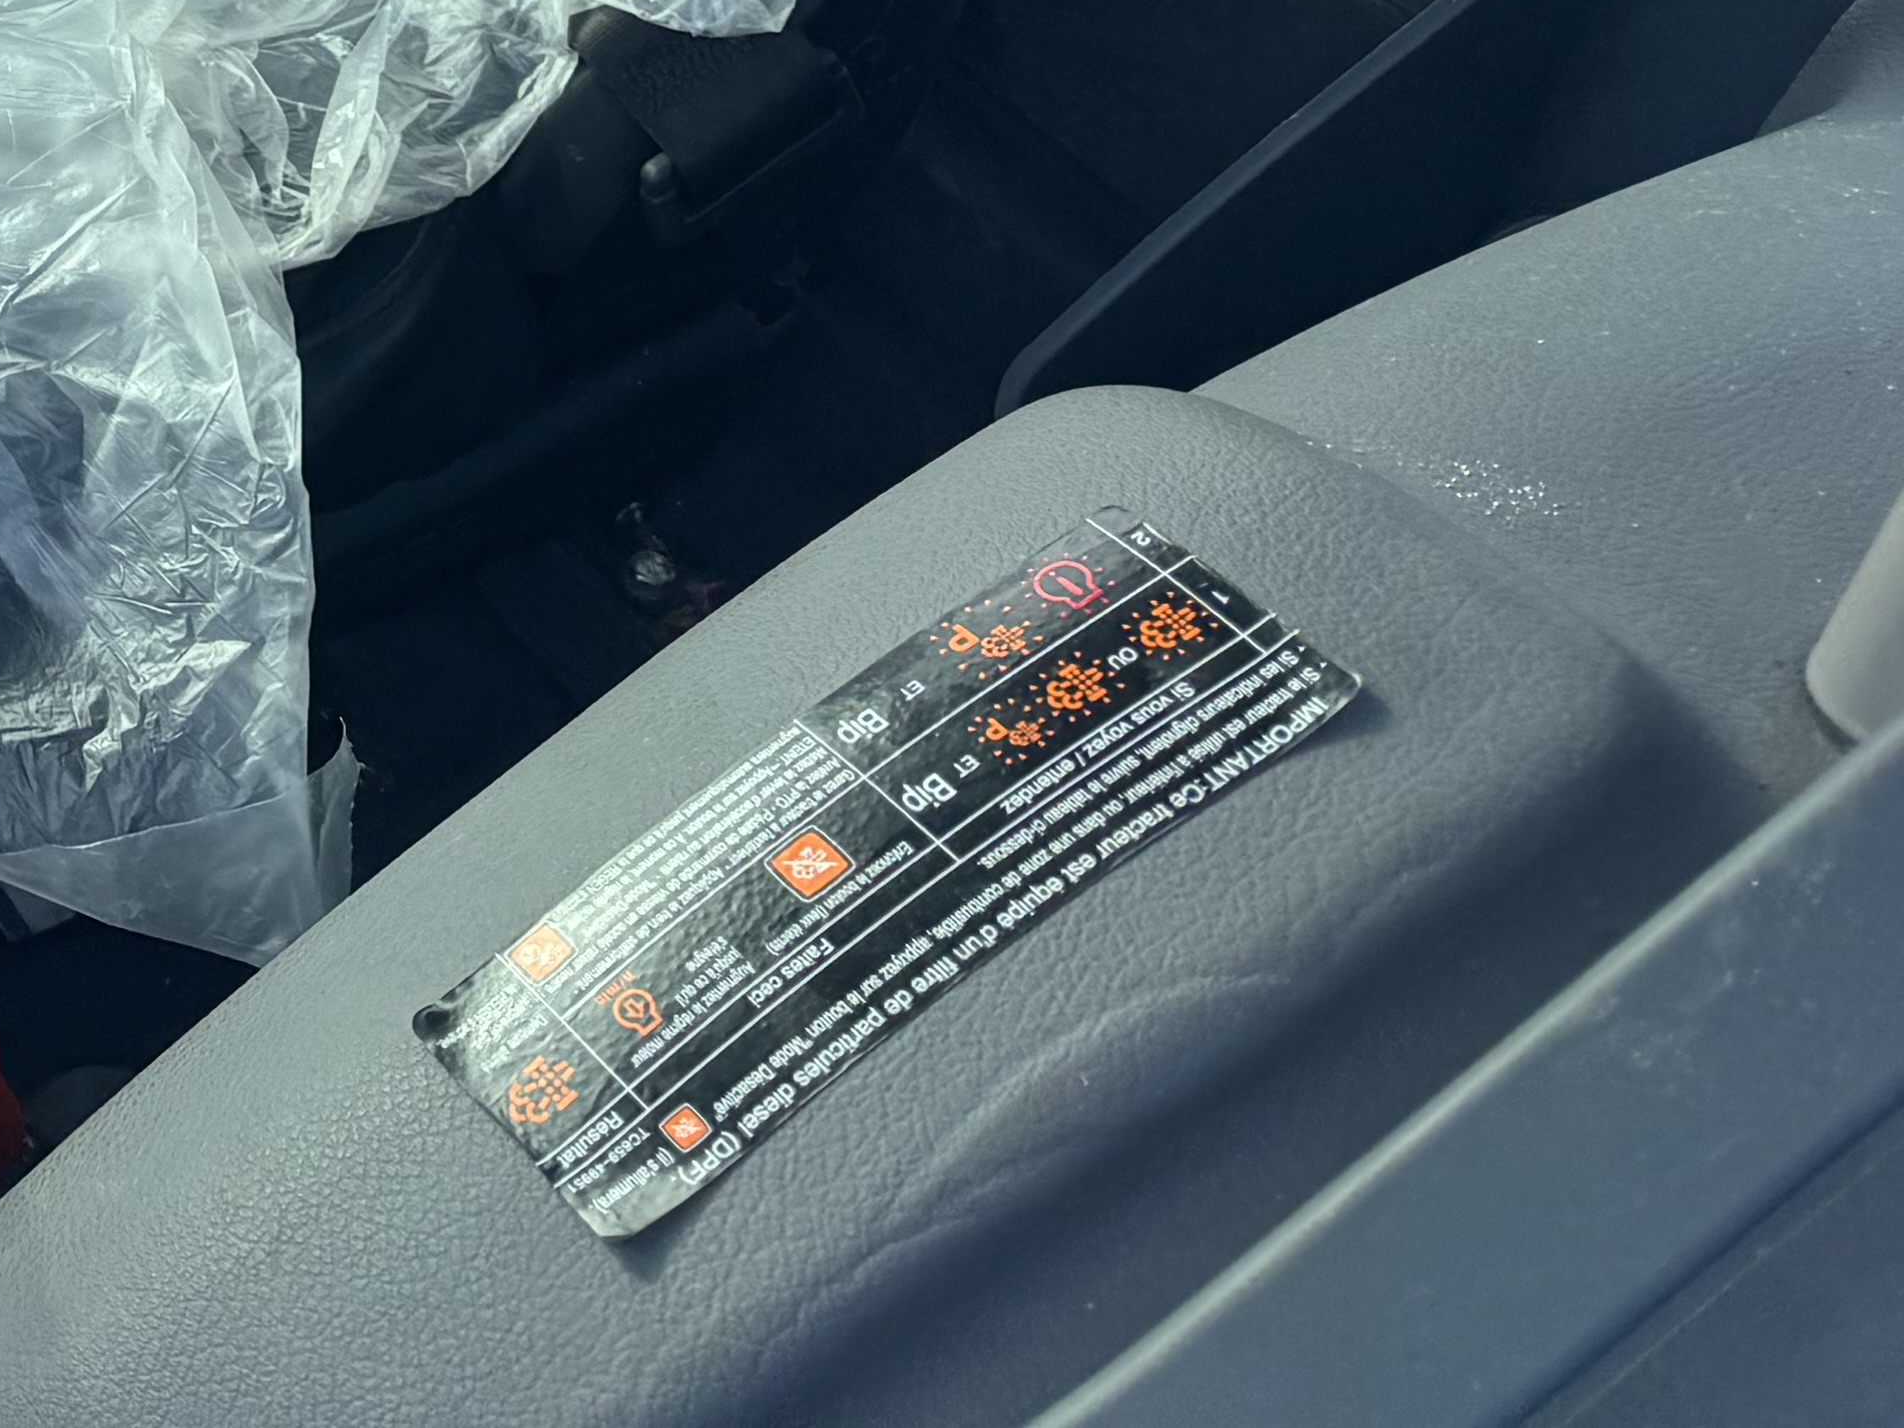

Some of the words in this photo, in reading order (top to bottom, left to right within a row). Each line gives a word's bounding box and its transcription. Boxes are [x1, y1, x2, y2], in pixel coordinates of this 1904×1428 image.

[1127, 529, 1154, 548] 2
[1103, 644, 1141, 671] OU
[1256, 660, 1286, 681] les
[1274, 649, 1301, 668] Si
[895, 678, 928, 702] ET
[1284, 676, 1307, 693] le
[1296, 665, 1323, 684] Si
[1167, 680, 1198, 702] Si
[1194, 673, 1268, 723] indicateurs
[1239, 686, 1296, 726] tracteur
[1128, 693, 1174, 725] vous
[828, 702, 891, 751] Bip
[1075, 716, 1135, 758] voyez
[1131, 712, 1205, 764] clignotent,
[1220, 717, 1249, 738] est
[1174, 753, 1195, 769] à
[1185, 731, 1230, 763] utilisé
[947, 752, 983, 779] ET
[1098, 754, 1143, 786] suivre
[772, 786, 801, 810] PTO
[889, 765, 960, 820] Bip
[996, 757, 1079, 816] entendez
[1085, 779, 1108, 796] le
[1040, 787, 1094, 827] tableau
[1098, 796, 1125, 817] ou
[1068, 809, 1109, 840] dans
[1090, 799, 1175, 863] tracteur
[974, 818, 1051, 875] ci-dessous.
[1045, 830, 1078, 855] une
[1015, 847, 1054, 877] zone
[1058, 850, 1101, 884] est
[820, 878, 861, 911] bouton
[998, 869, 1025, 890] de
[989, 870, 1068, 932] équipé
[633, 923, 653, 941] de
[950, 921, 1004, 964] d'un
[778, 935, 836, 983] Faites
[871, 929, 934, 981] appuyez
[691, 973, 711, 991] ce
[744, 972, 788, 1009] ceci
[855, 972, 885, 997] sur
[907, 954, 961, 998] filtre
[843, 988, 867, 1009] le
[879, 987, 918, 1019] de
[803, 998, 854, 1041] bouton
[626, 1033, 666, 1069] moteur
[786, 1004, 891, 1092] particules
[734, 1079, 800, 1138] diesel
[555, 1107, 624, 1172] Résultat
